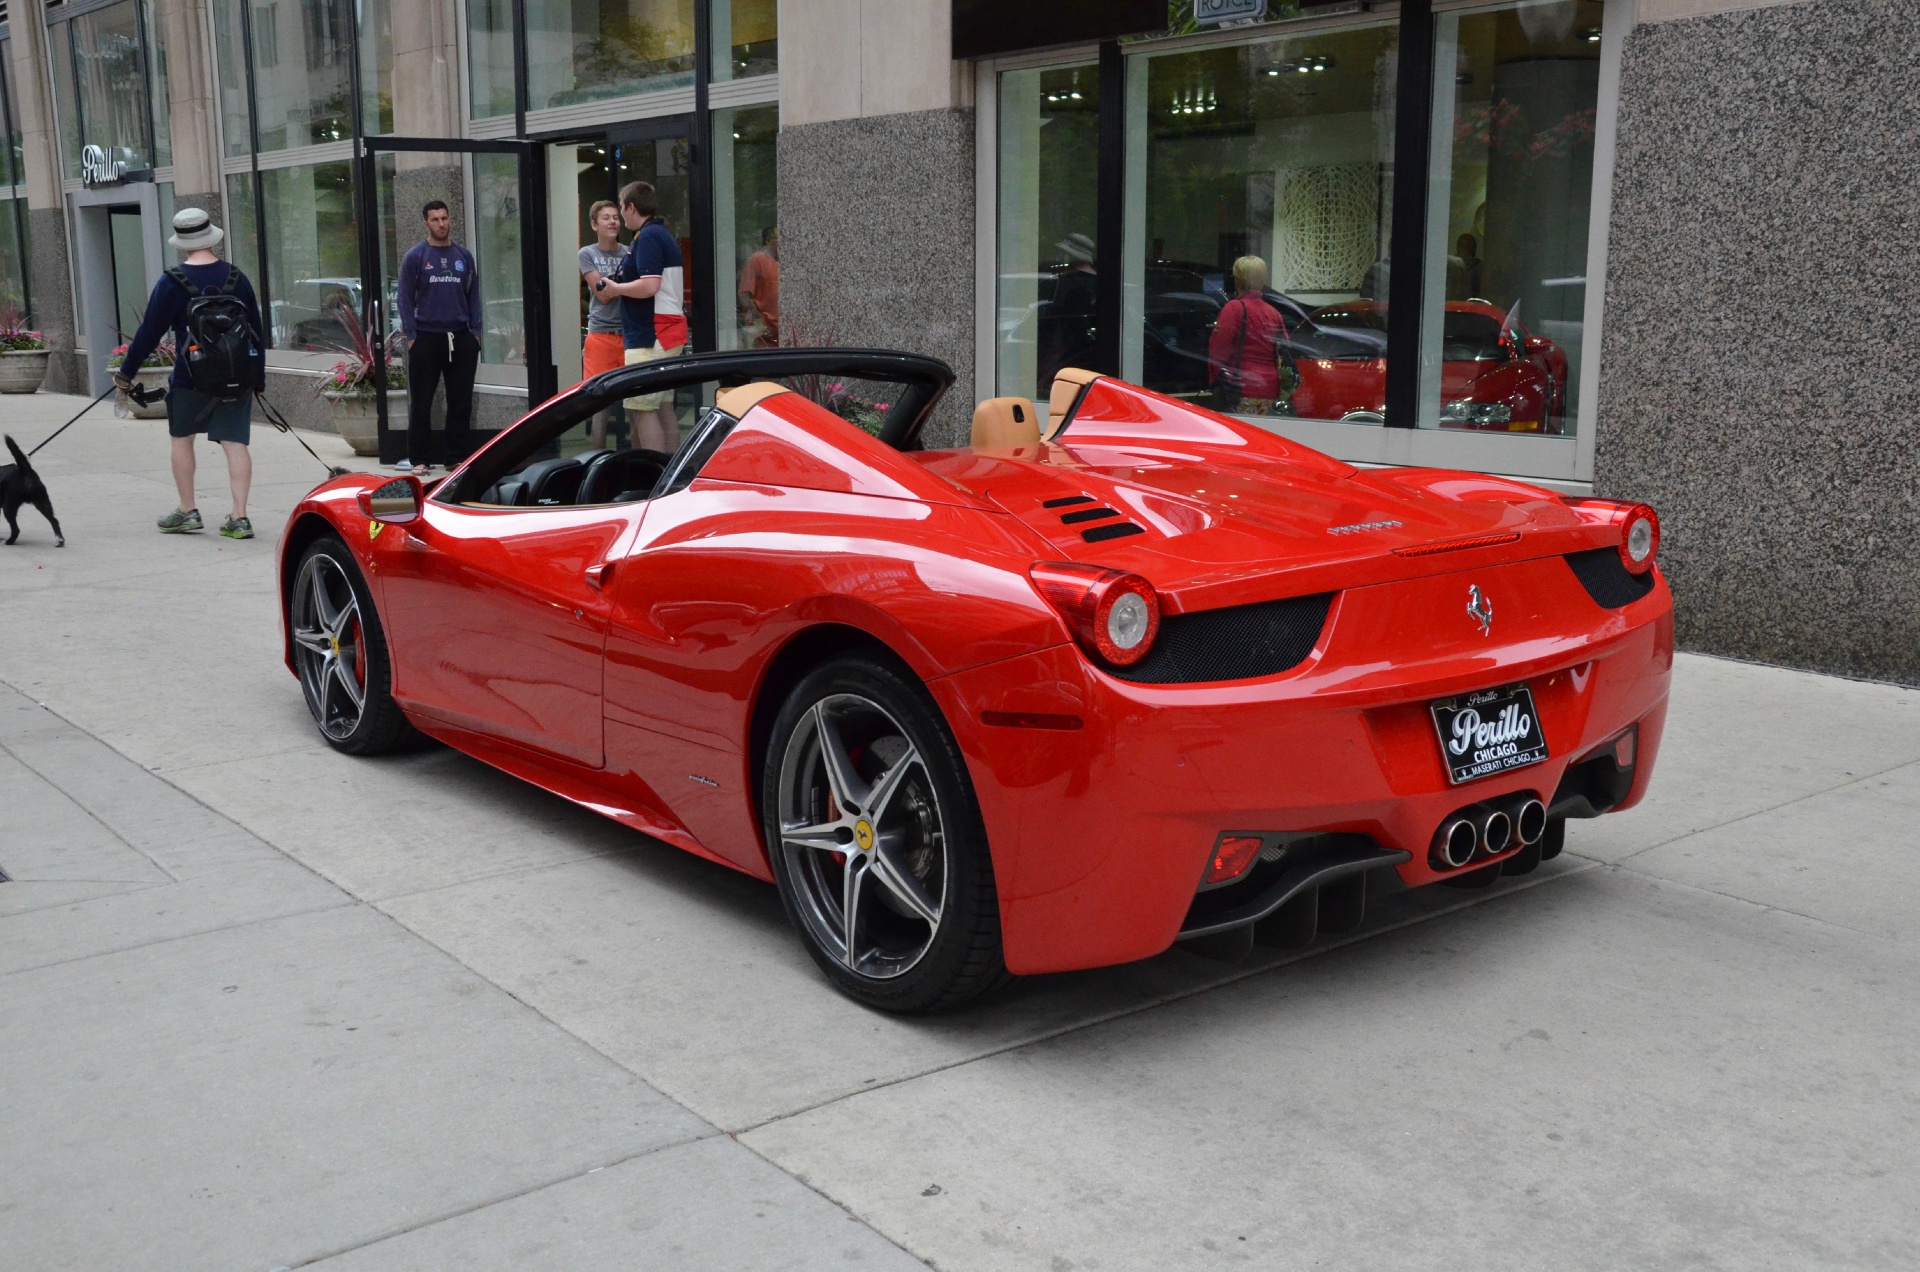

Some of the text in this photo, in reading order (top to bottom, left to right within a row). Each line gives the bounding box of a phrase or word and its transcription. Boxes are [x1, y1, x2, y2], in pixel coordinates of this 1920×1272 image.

[82, 144, 119, 184] Perillo
[1467, 691, 1499, 707] Perillo
[1448, 703, 1531, 755] Perillo
[1471, 761, 1503, 775] MASERATI
[1503, 752, 1531, 768] CHICAGO
[1473, 742, 1518, 763] CHICAGO
